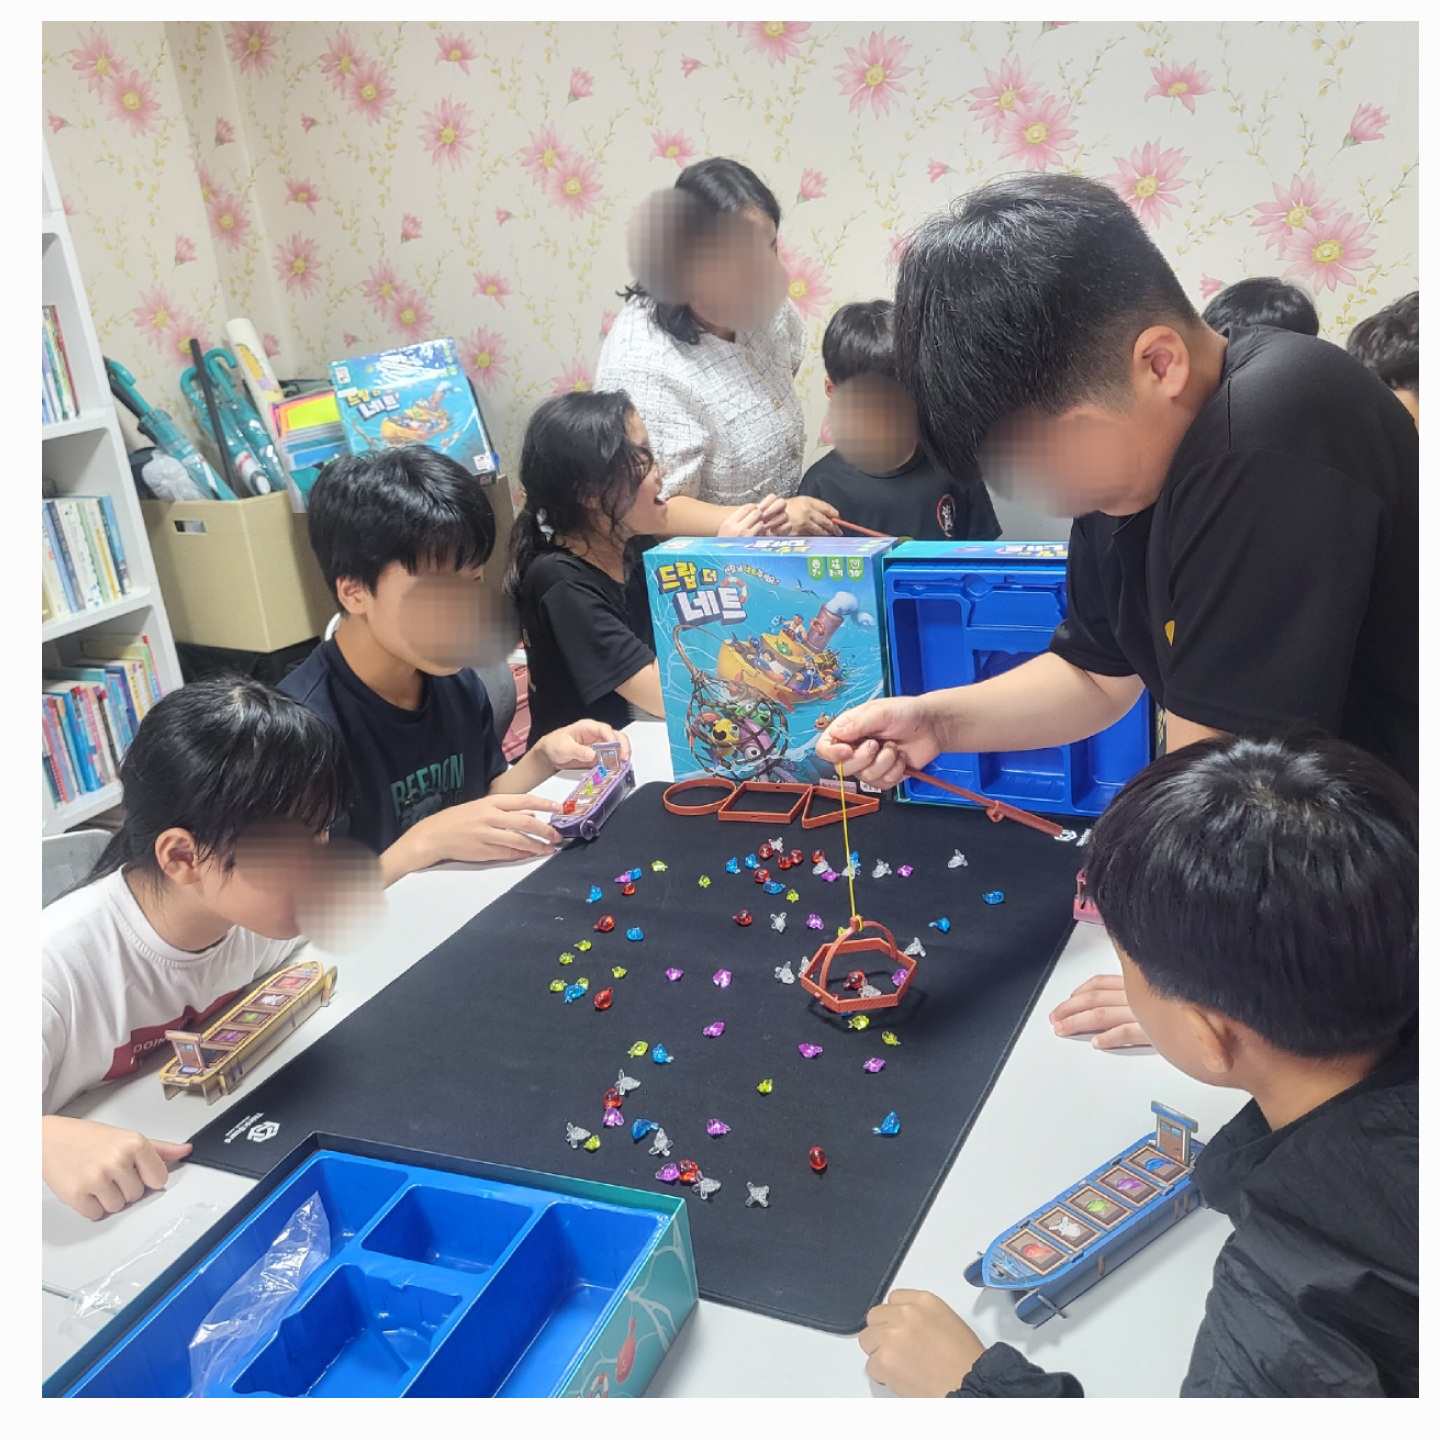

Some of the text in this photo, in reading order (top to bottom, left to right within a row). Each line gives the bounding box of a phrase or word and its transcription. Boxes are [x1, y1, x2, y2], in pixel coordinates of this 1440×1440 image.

[656, 561, 718, 594] 드랍 더
[673, 586, 748, 630] 네트
